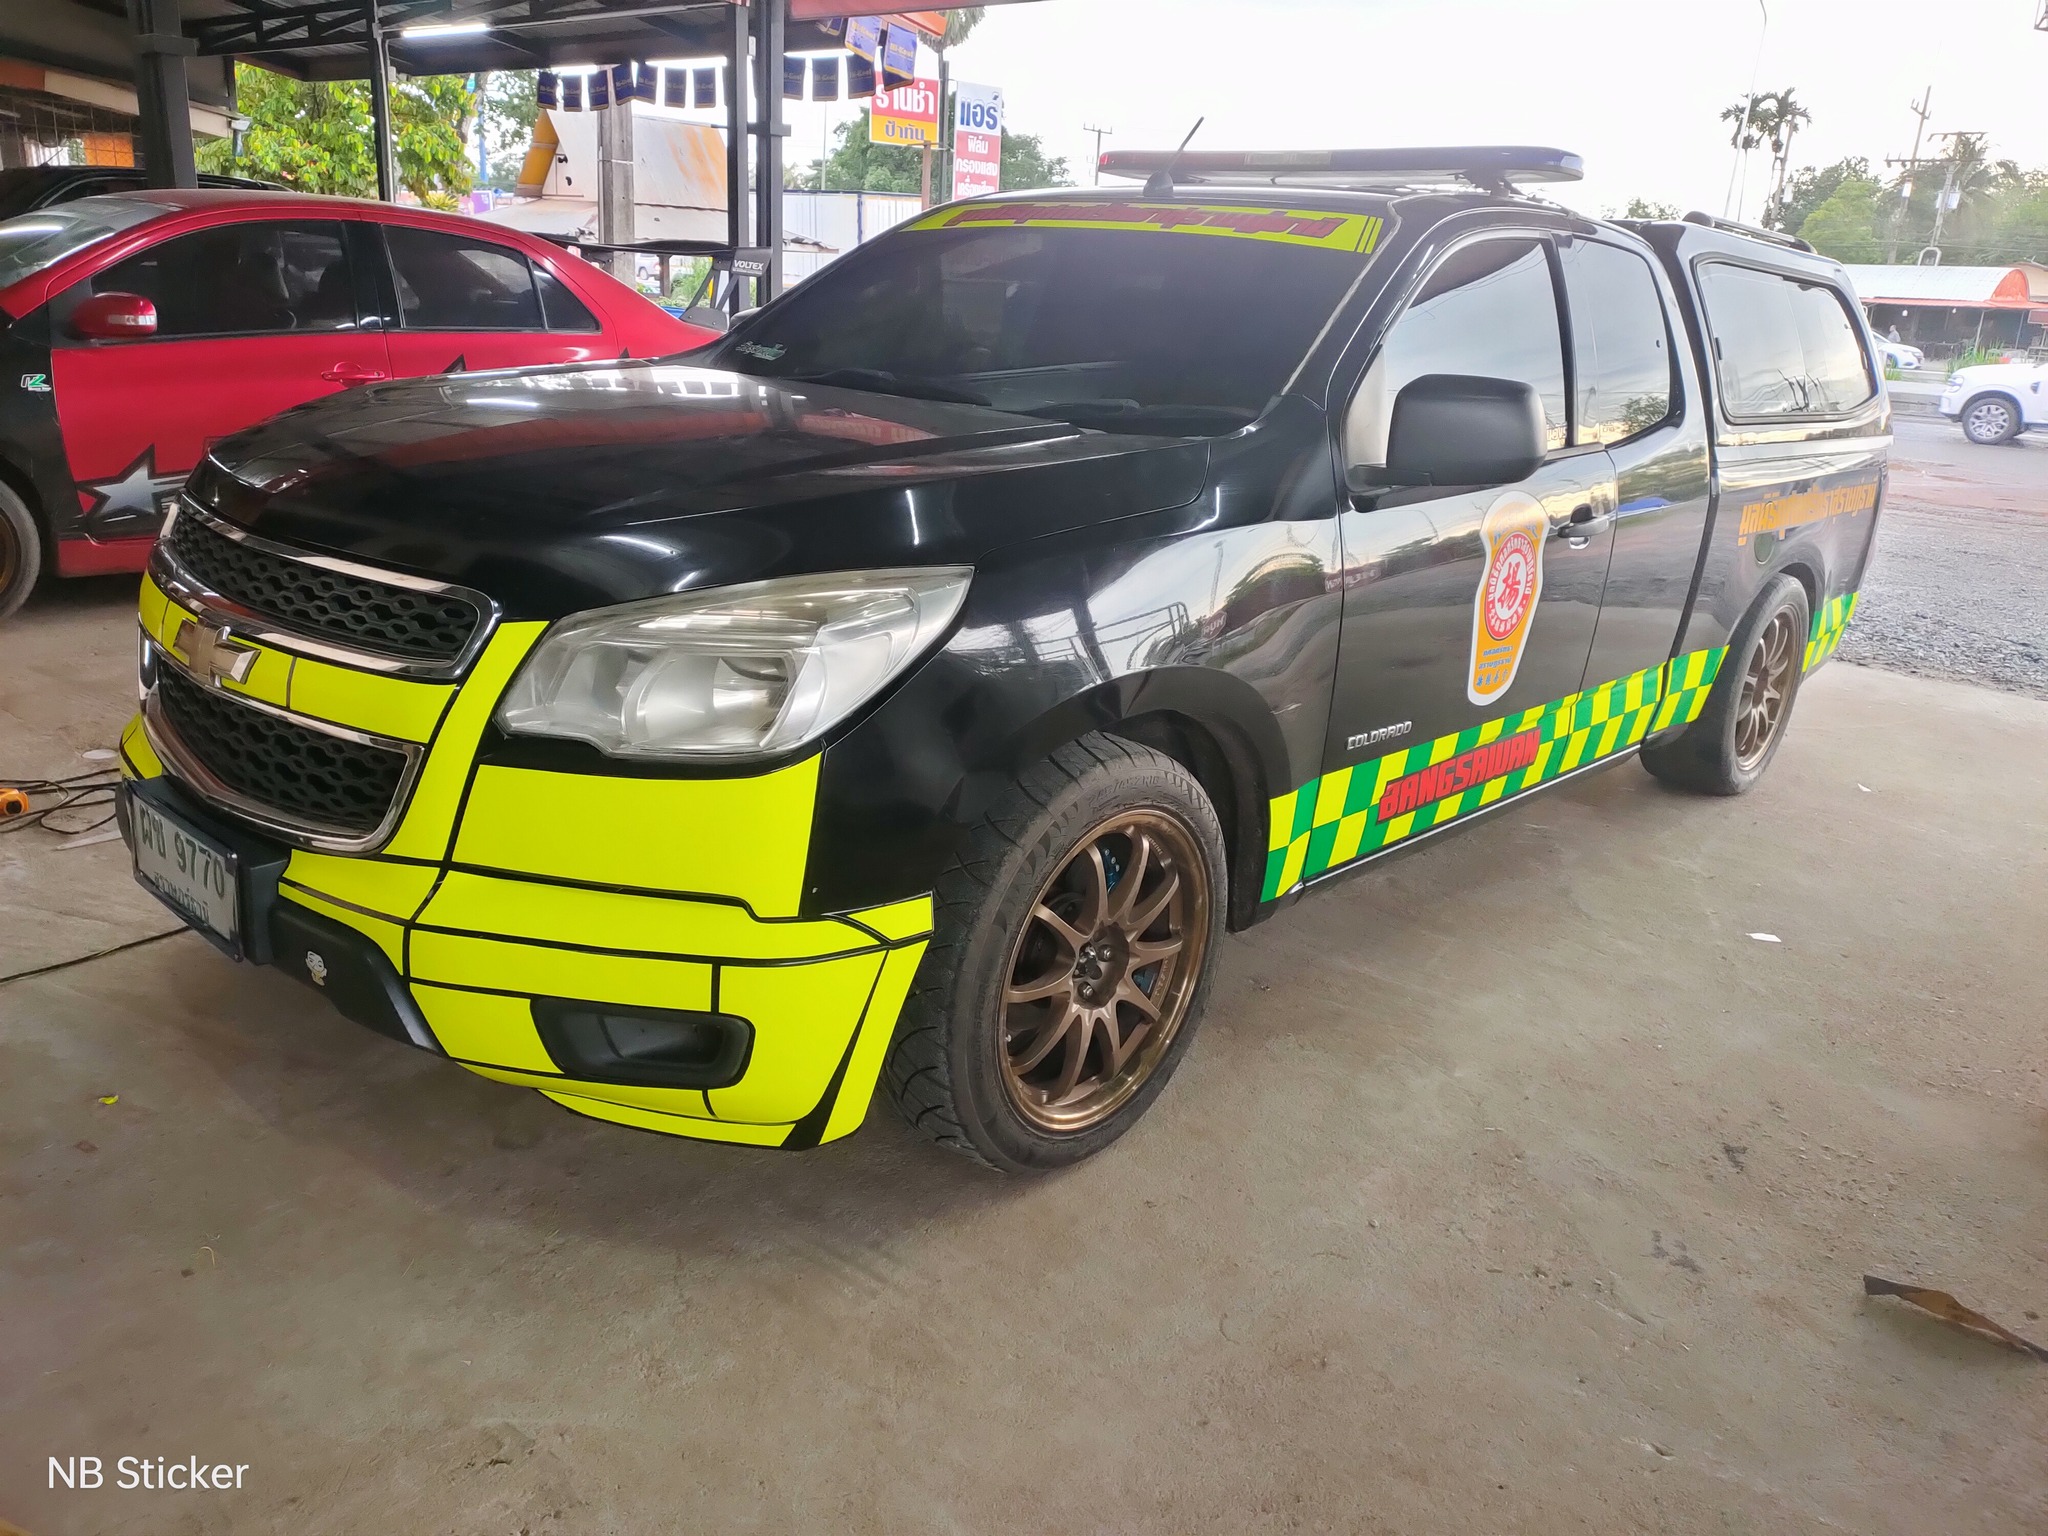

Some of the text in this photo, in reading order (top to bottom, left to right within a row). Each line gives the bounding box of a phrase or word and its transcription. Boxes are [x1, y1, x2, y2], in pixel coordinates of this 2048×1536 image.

[875, 82, 935, 115] รานชำ
[960, 91, 999, 130] แอร์
[956, 158, 998, 176] กรองแสง
[733, 260, 765, 270] VOLTEX
[1347, 721, 1412, 750] COLORADO
[1377, 729, 1541, 822] BANGSAWAN
[174, 831, 225, 900] 9770
